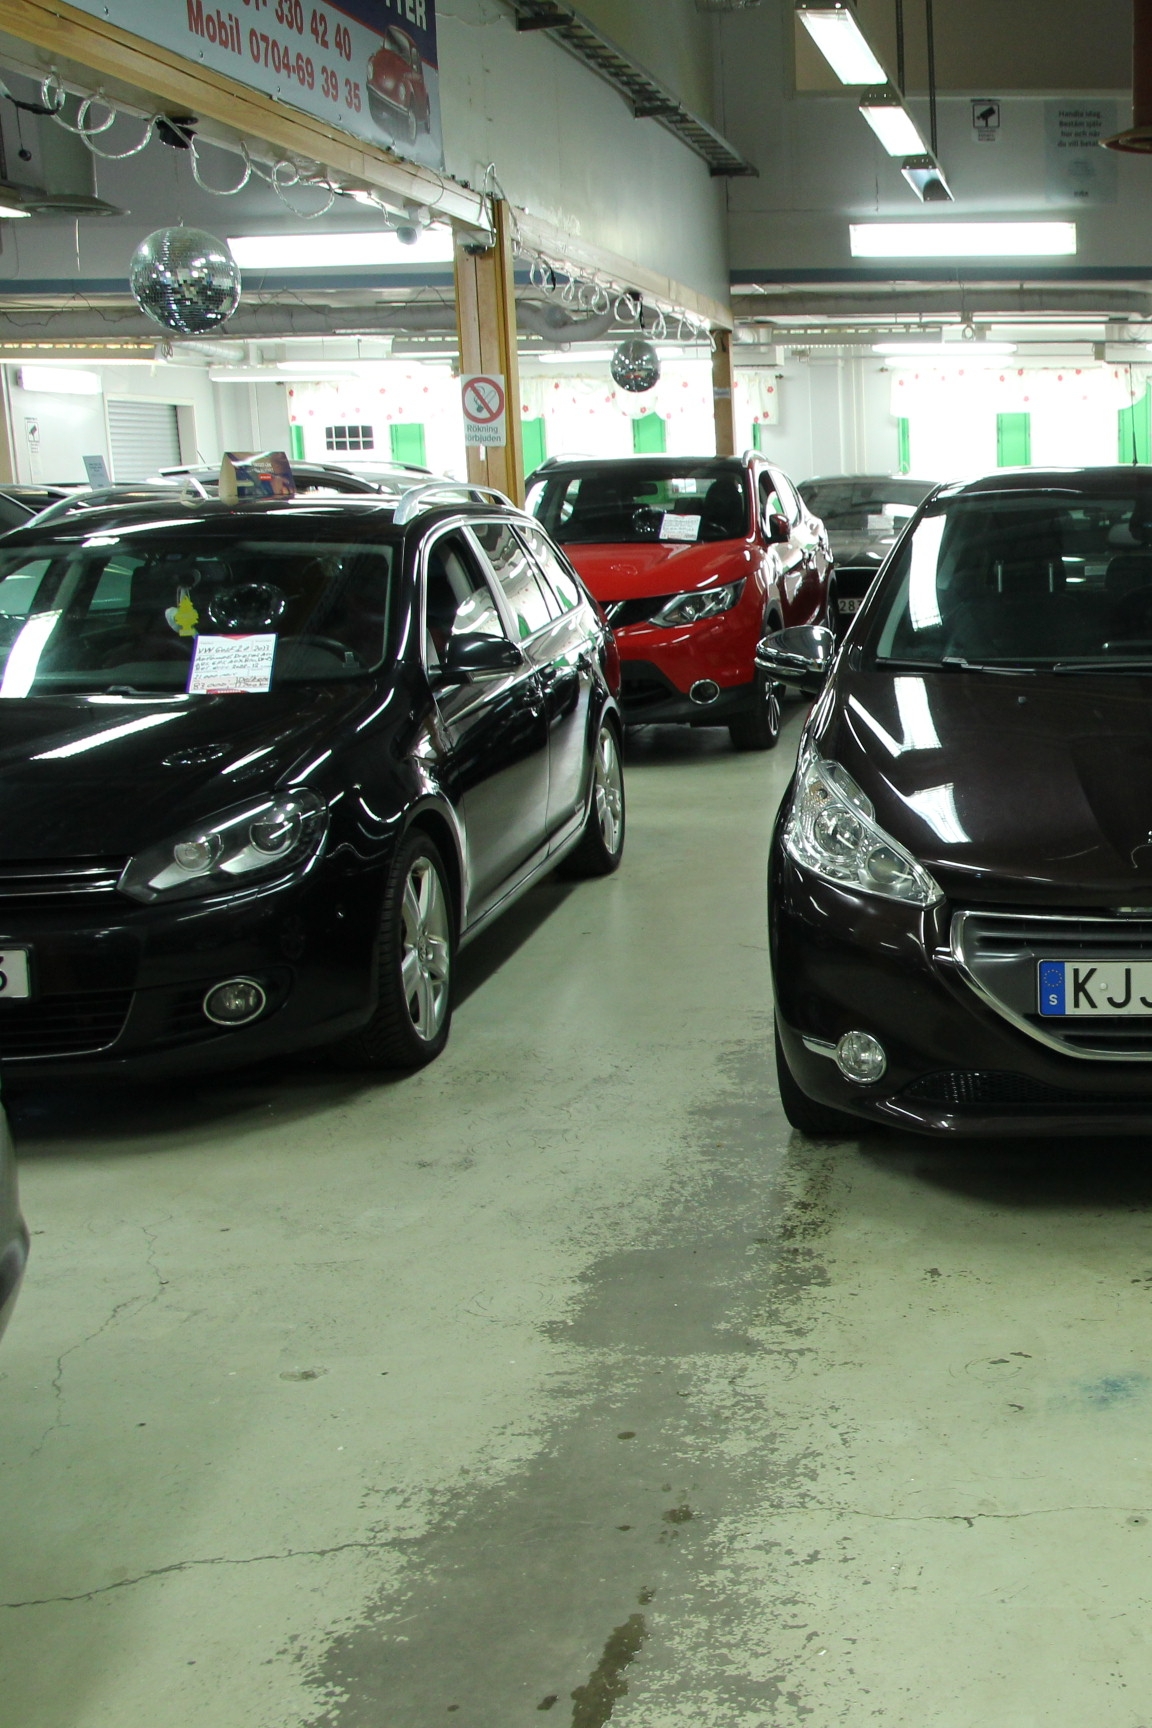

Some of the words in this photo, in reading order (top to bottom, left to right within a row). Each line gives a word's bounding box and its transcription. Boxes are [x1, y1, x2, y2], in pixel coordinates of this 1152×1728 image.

[386, 0, 427, 31] ER
[310, 8, 329, 50] 42
[335, 23, 352, 62] 40
[187, 0, 242, 55] Mobil
[249, 28, 315, 90] 0704-69
[321, 65, 339, 102] 39
[344, 78, 362, 113] 35
[467, 424, 498, 434] Rökning
[1049, 994, 1058, 1006] S
